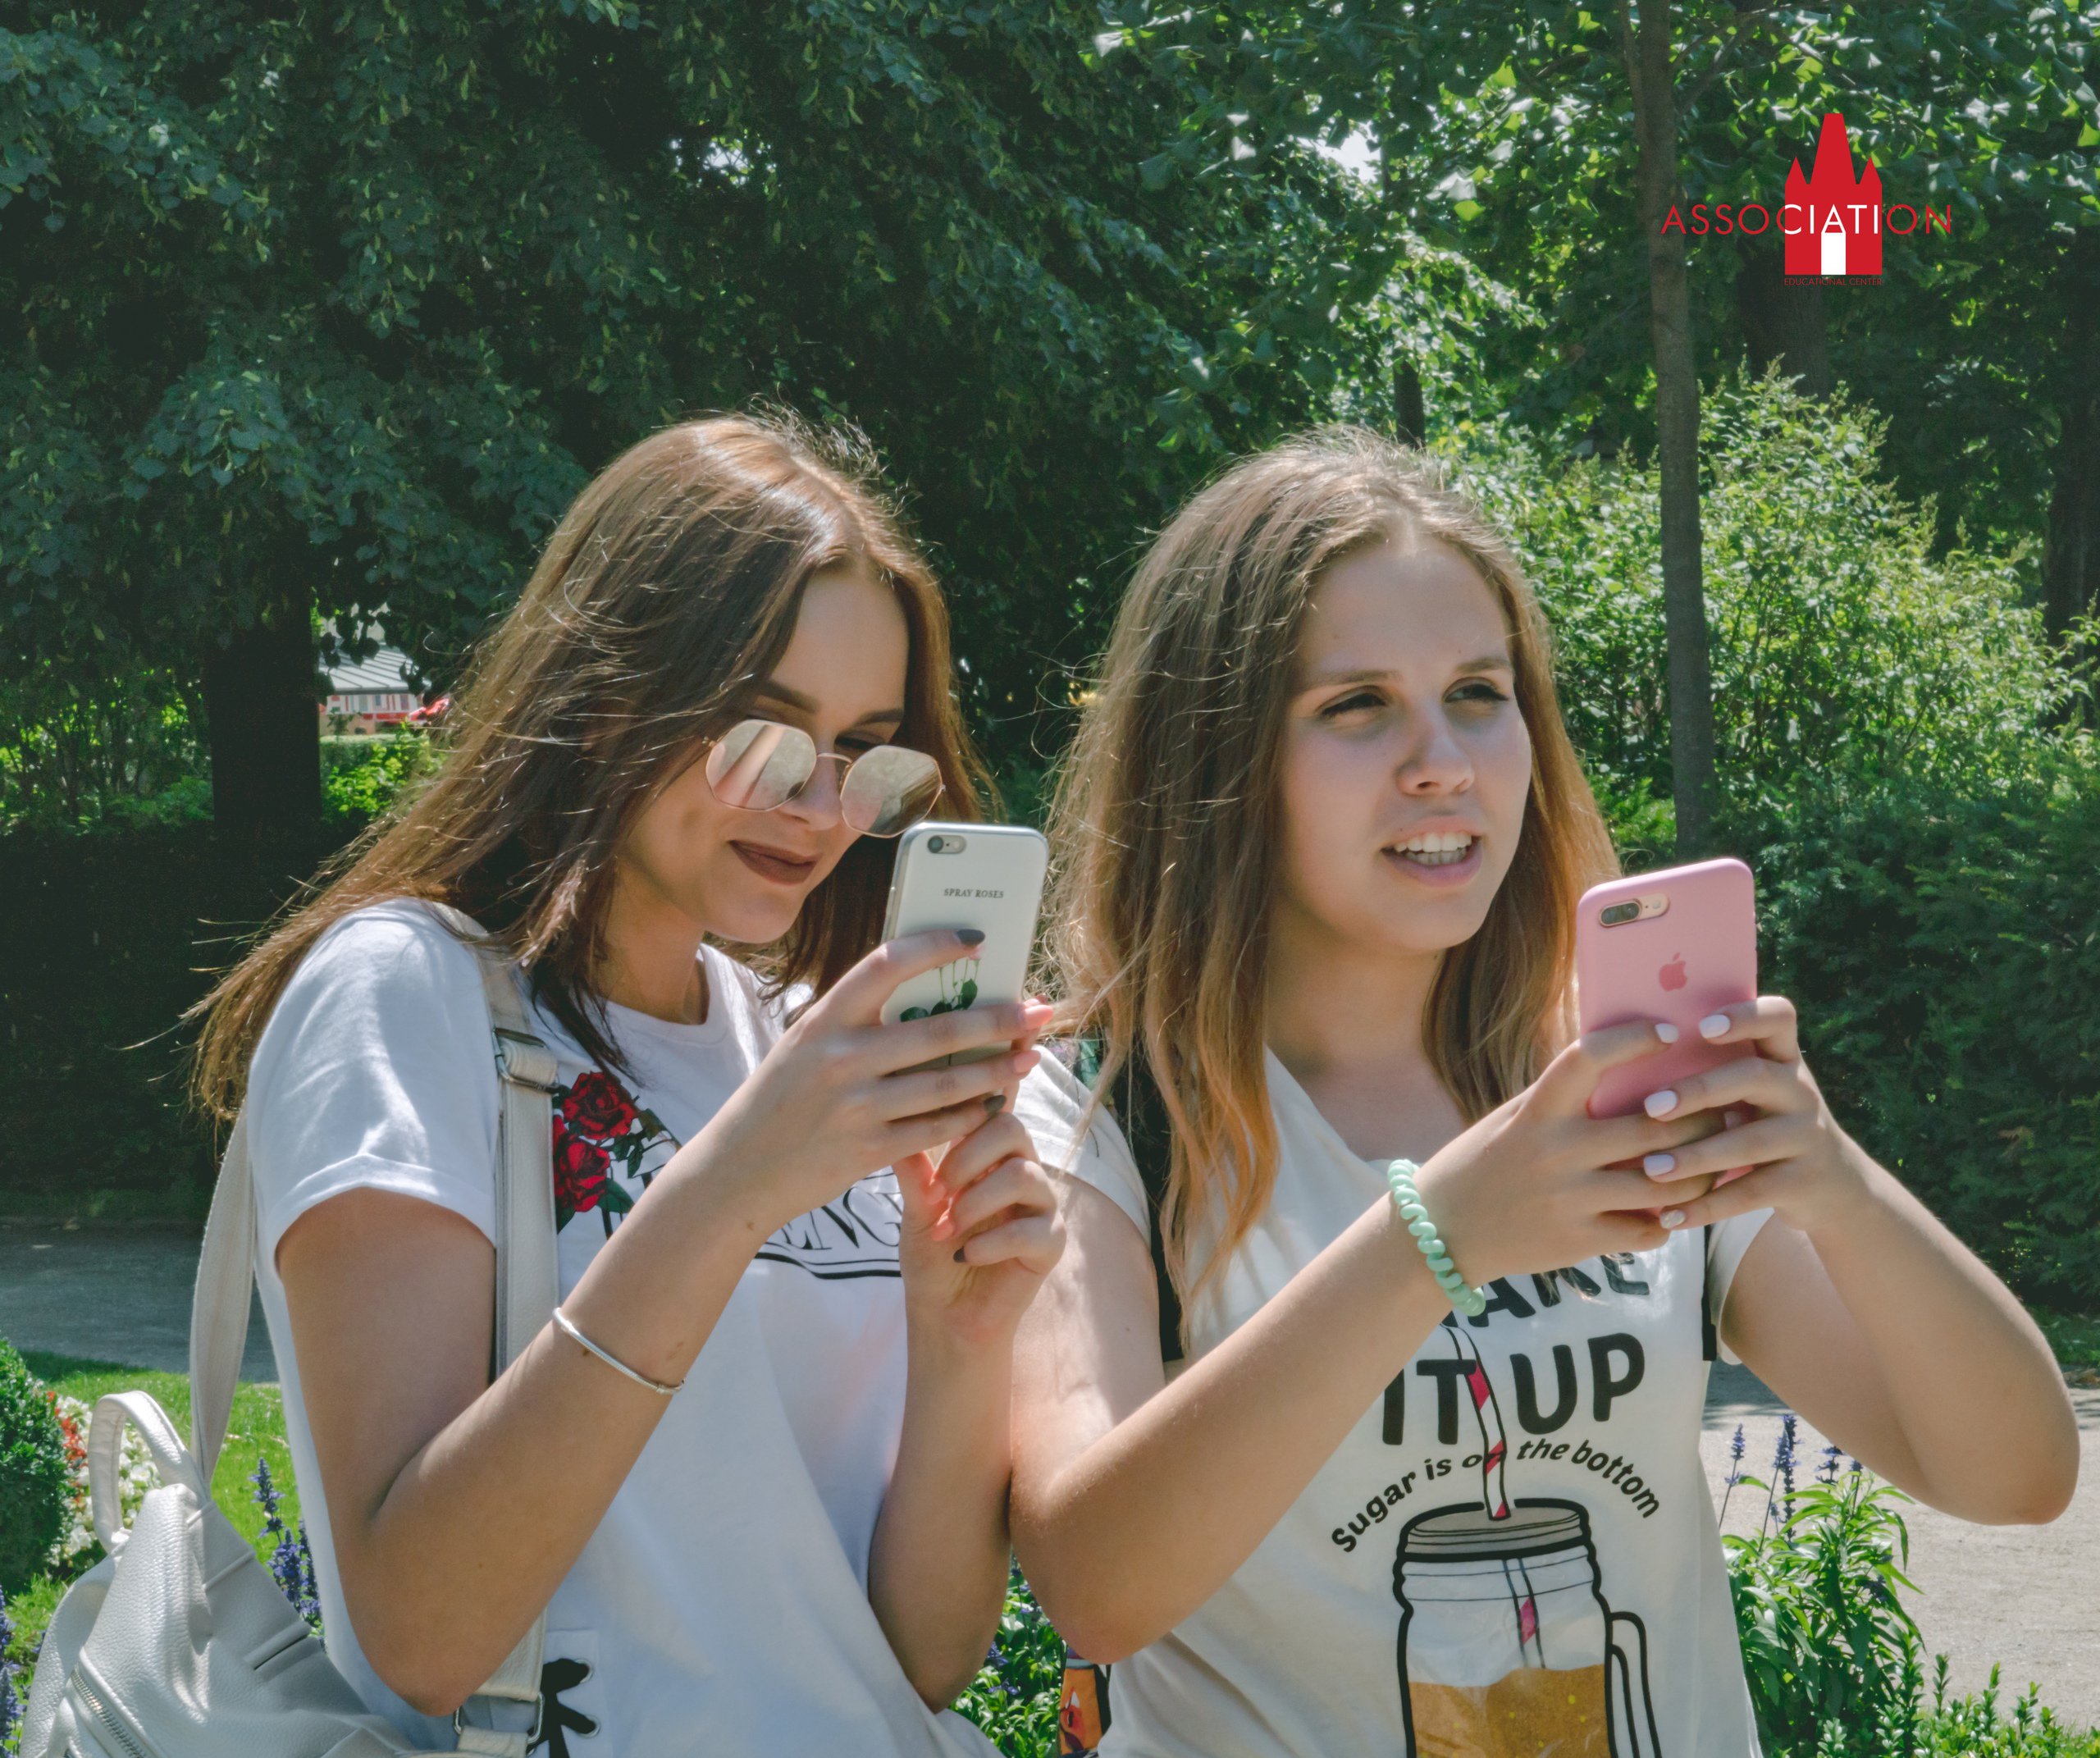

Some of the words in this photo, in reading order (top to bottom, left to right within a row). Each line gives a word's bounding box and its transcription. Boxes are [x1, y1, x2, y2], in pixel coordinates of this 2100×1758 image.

[943, 888, 973, 897] SPRAY
[975, 889, 1004, 899] ROSES
[1382, 1358, 1477, 1445] IT
[1509, 1332, 1645, 1435] UP
[1331, 1471, 1417, 1553] Sugar
[1423, 1458, 1452, 1481] is
[1517, 1438, 1570, 1460] the
[1571, 1440, 1659, 1518] bottom
